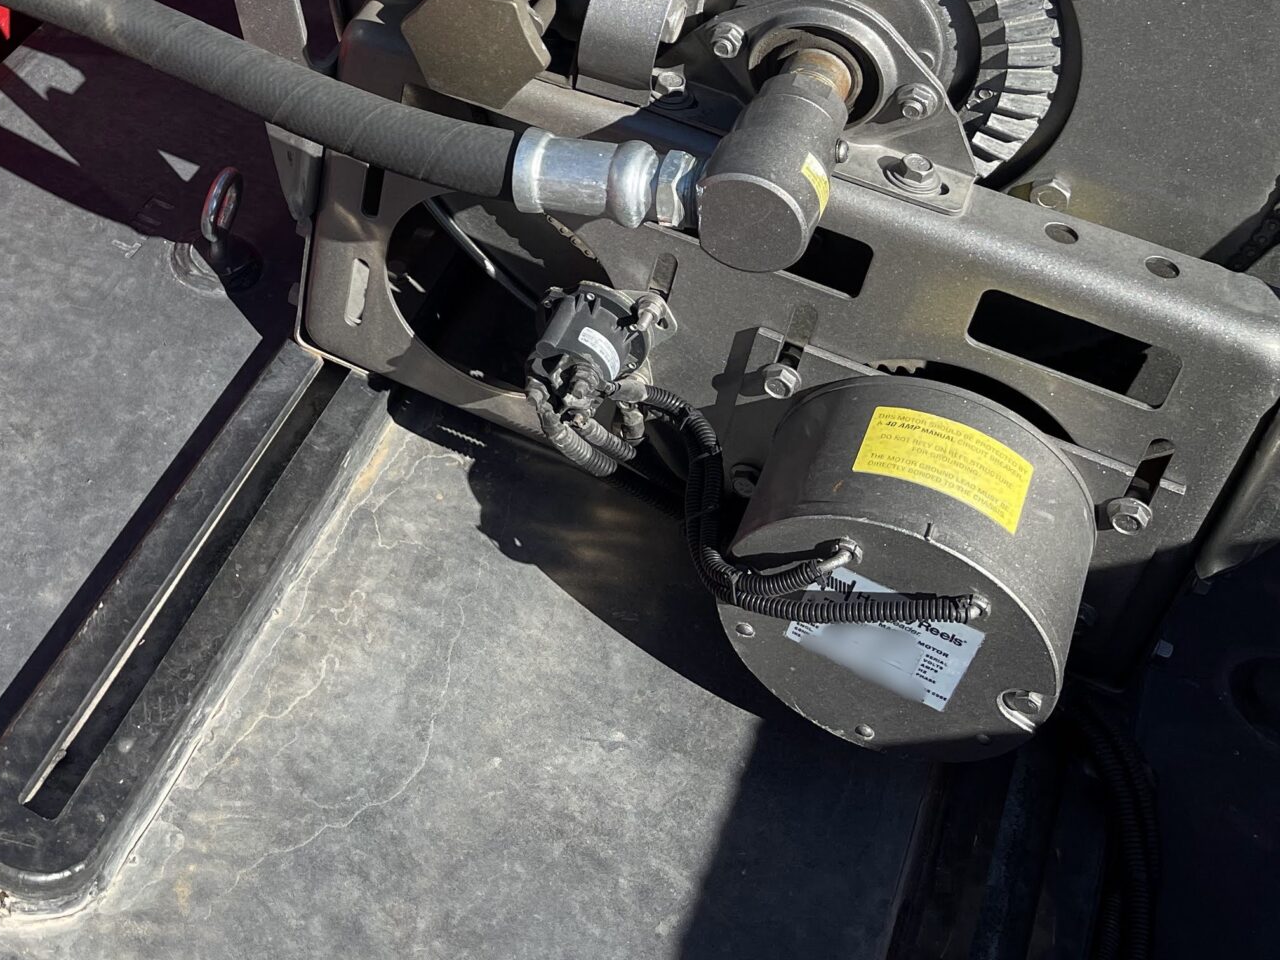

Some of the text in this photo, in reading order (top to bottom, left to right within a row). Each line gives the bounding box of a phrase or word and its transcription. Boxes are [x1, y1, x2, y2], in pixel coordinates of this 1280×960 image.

[897, 415, 927, 425] MOTOR
[928, 421, 962, 436] SHOULD
[975, 439, 1018, 467] PROTECTED
[898, 422, 921, 431] AMP
[921, 428, 956, 442] MANUAL
[957, 440, 988, 458] CIRCUIT
[894, 434, 910, 442] NOT
[934, 445, 947, 454] ON
[969, 460, 1014, 489] STRUCTURE
[911, 447, 928, 456] FOR
[867, 460, 906, 471] DIRECTLY
[908, 467, 941, 483] BONDED
[956, 485, 971, 496] THE
[887, 455, 917, 466] MOTOR
[919, 462, 954, 479] GROUND
[956, 477, 976, 490] LEAD
[917, 621, 963, 647] Reels
[917, 640, 949, 658] MOTOR
[920, 663, 938, 673] AMPS
[923, 658, 943, 670] VOLTS
[925, 654, 948, 667] SERIAL
[915, 672, 936, 684] PHASE
